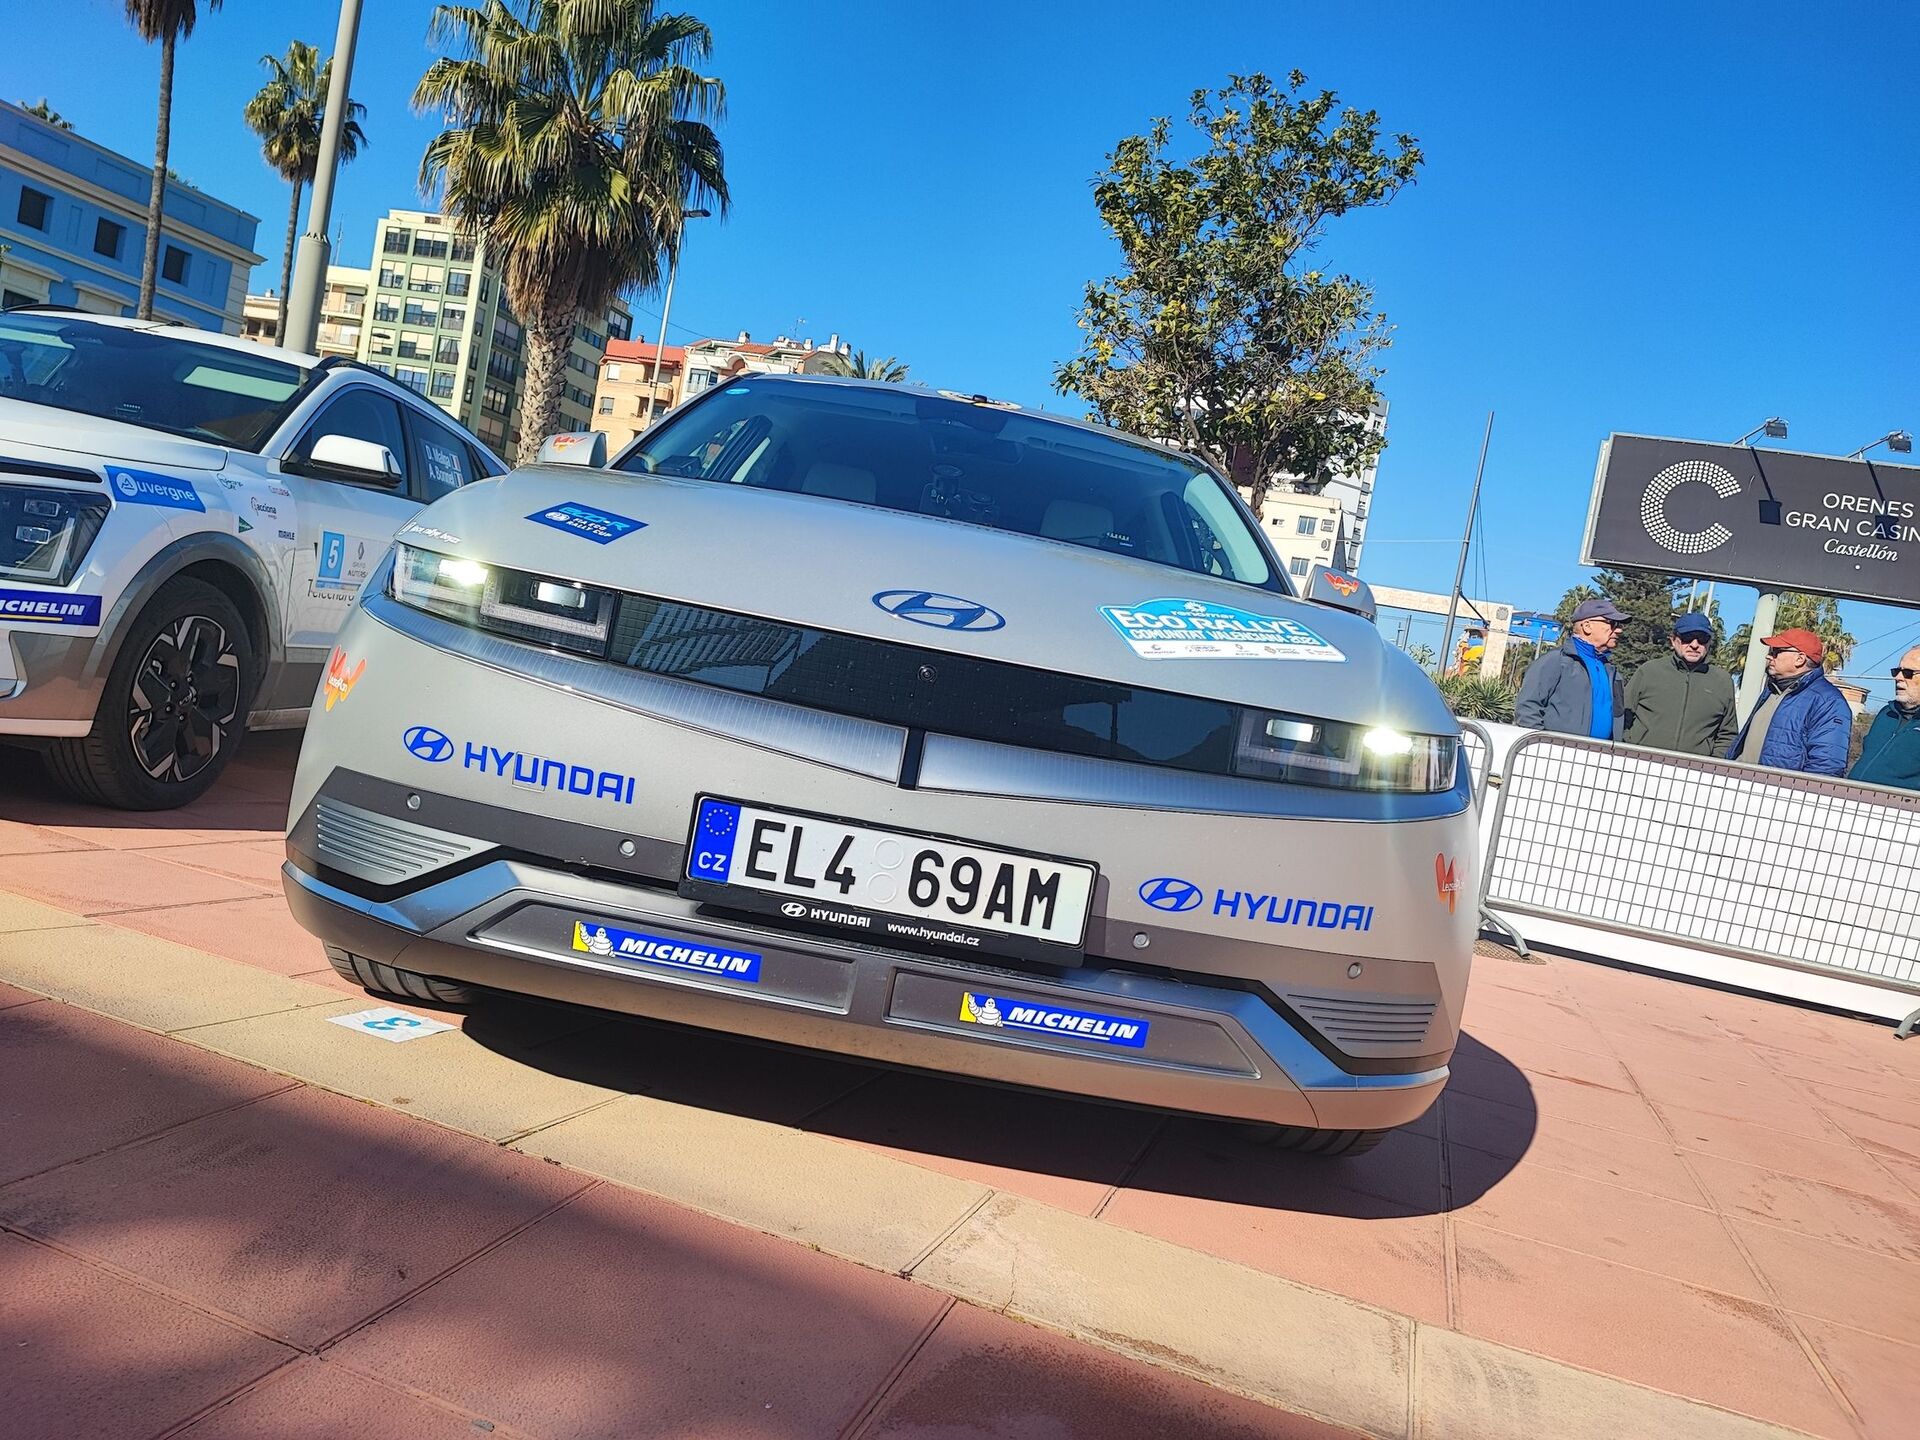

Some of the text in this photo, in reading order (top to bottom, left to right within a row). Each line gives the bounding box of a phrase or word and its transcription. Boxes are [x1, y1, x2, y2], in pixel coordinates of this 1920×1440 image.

[1823, 493, 1914, 519] ORENES
[566, 520, 613, 537] RALLY CUP
[588, 522, 607, 531] ECO
[1785, 511, 1850, 533] GRAN
[328, 539, 340, 569] 5
[1823, 538, 1898, 561] Castellón
[1109, 608, 1310, 637] ECO RALLYE
[1128, 629, 1206, 640] COMUNITAT
[1205, 630, 1290, 643] VALENCIANA
[464, 741, 635, 804] HYUNDAI
[697, 851, 726, 873] CZ
[745, 818, 1061, 931] EL4 69AM
[1213, 889, 1374, 932] HYUNDAI
[810, 908, 980, 947] HYUNDAI www.hyundai.cz
[619, 937, 752, 974] MICHELIN
[1007, 1006, 1139, 1041] MICHELIN
